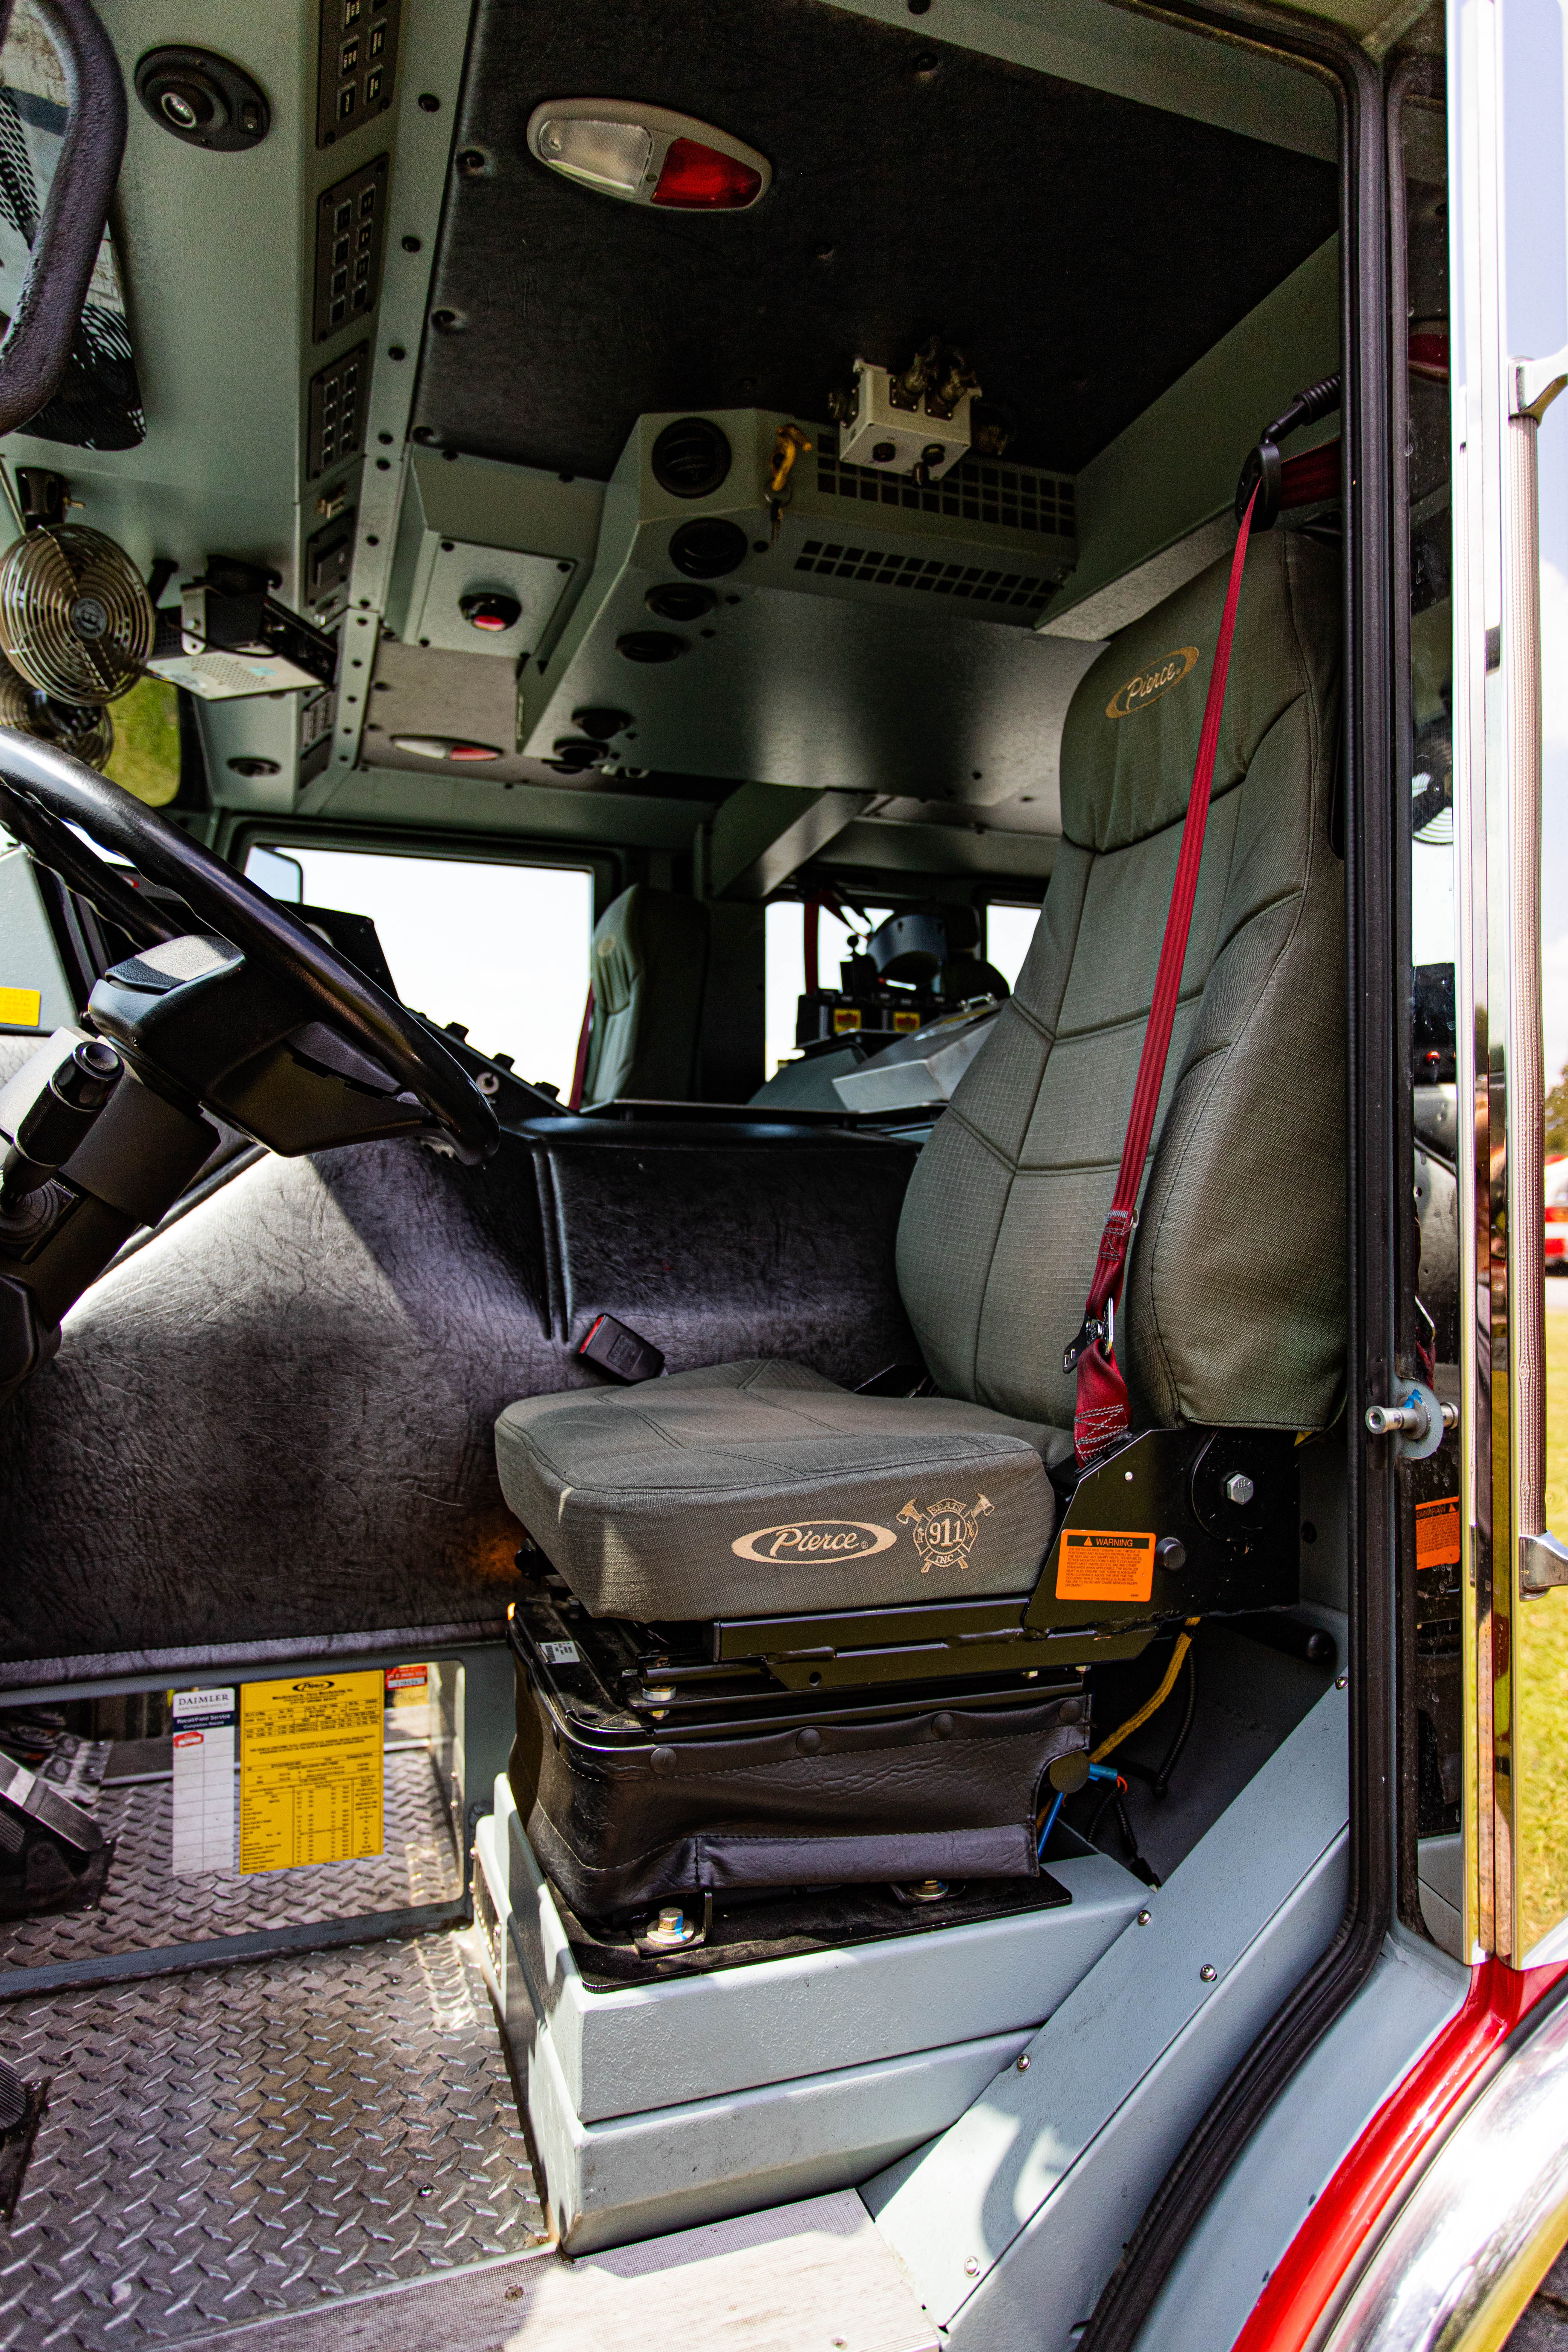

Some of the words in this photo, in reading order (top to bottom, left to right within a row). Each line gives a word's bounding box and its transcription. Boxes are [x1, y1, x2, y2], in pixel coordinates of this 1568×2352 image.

[1125, 663, 1176, 710] Pierce
[931, 1502, 963, 1513] SEATS
[929, 1519, 962, 1547] 911
[769, 1528, 859, 1558] Pierce
[1096, 1538, 1133, 1547] WARNING
[934, 1554, 954, 1564] INC
[178, 1694, 229, 1706] DAIMLER
[176, 1716, 209, 1724] Recall/Field
